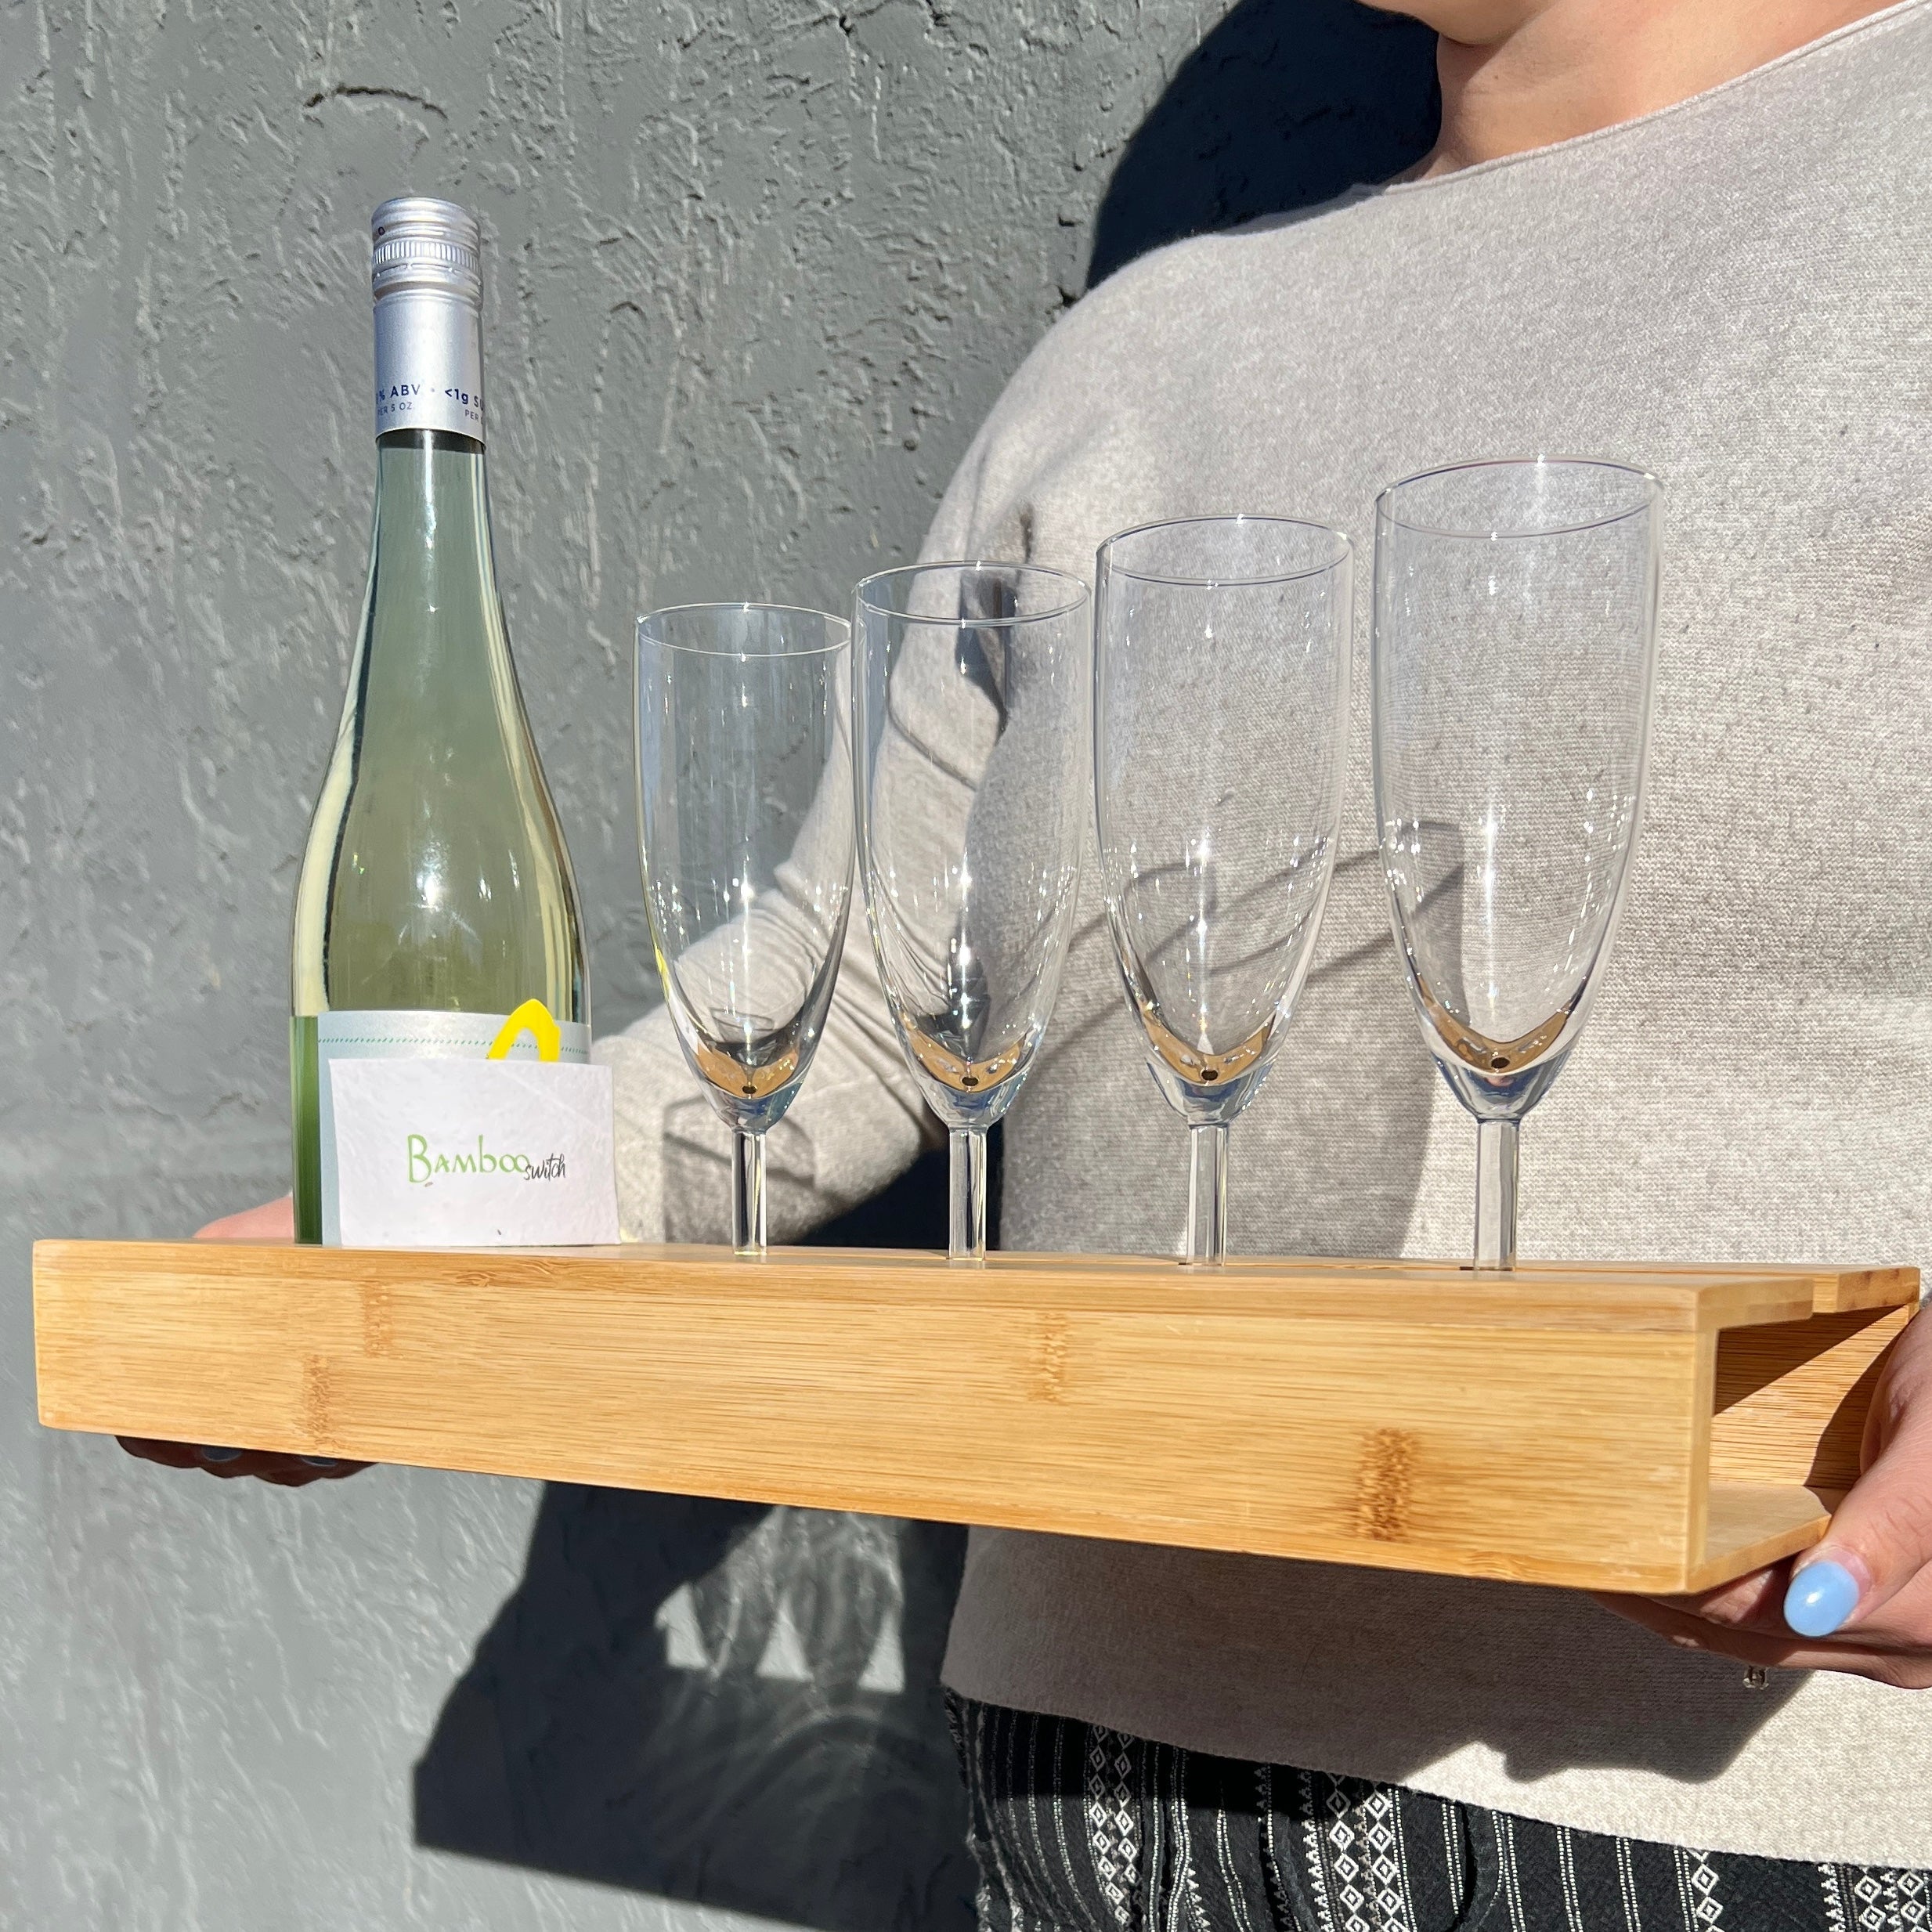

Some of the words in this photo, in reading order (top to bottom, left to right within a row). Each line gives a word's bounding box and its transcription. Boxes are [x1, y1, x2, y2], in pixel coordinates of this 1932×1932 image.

[390, 384, 421, 398] ABV
[444, 388, 469, 405] <1g
[464, 409, 479, 422] PER
